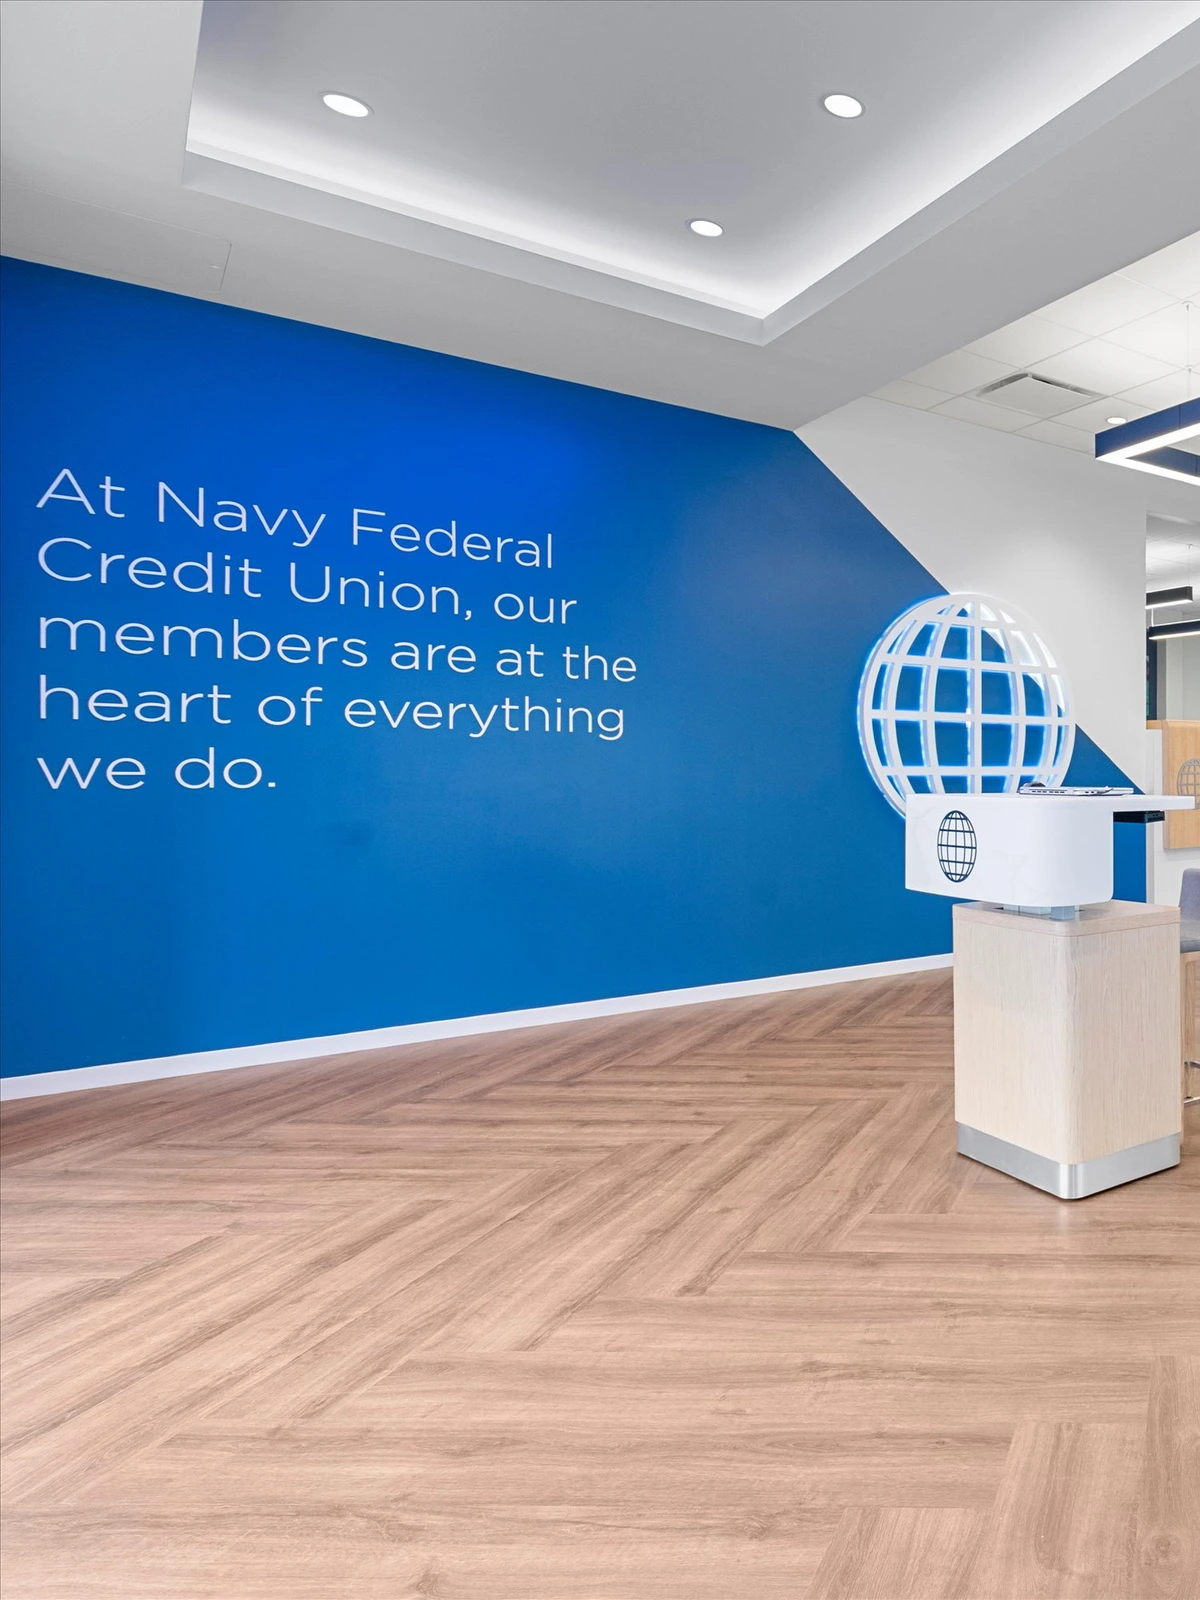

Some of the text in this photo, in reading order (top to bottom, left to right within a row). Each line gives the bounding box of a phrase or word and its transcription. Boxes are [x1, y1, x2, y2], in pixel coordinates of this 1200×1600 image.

[36, 468, 552, 569] At Navy Federal
[38, 537, 577, 625] Credit Union, our
[39, 617, 637, 683] members are at the
[39, 674, 624, 741] heart of everything
[37, 746, 276, 790] we do.
